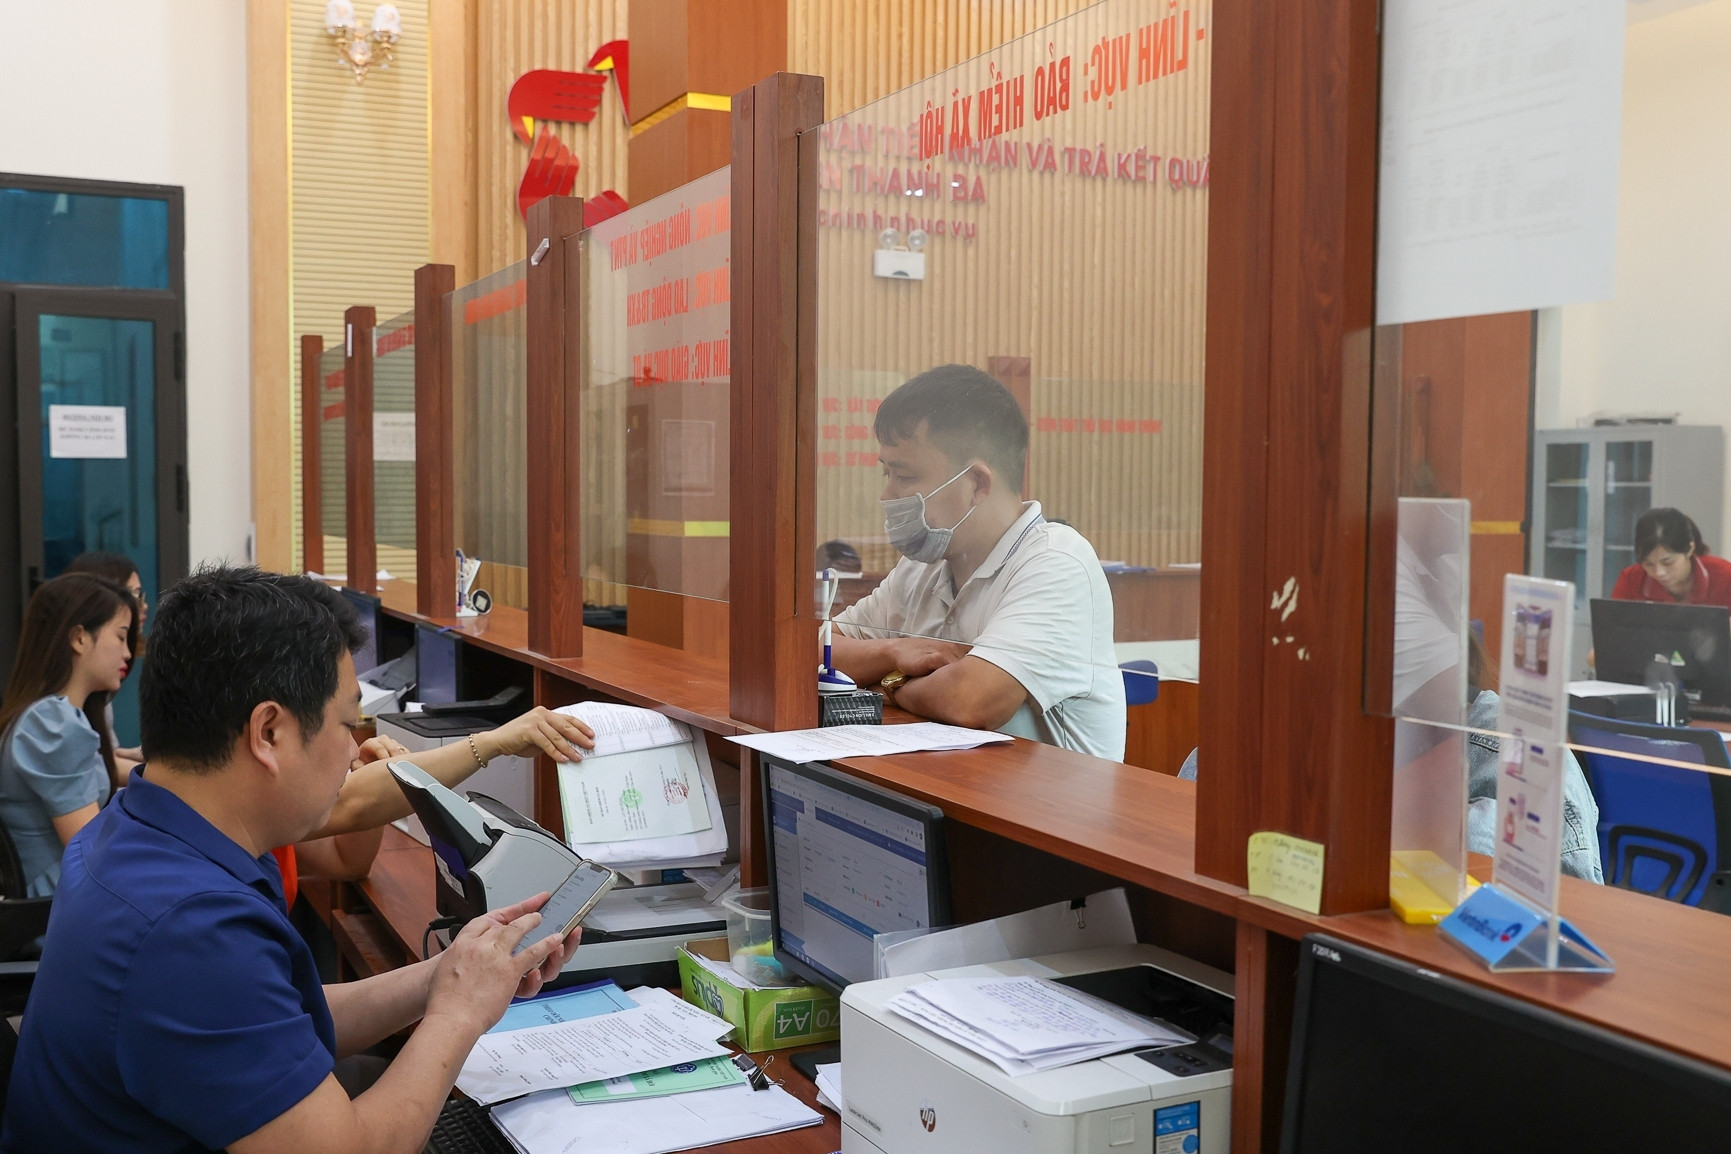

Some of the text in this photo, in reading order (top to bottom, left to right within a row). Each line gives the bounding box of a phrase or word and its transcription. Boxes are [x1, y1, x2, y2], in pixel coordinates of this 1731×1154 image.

[1025, 138, 1058, 172] VÀ
[1064, 144, 1109, 179] TRẢ
[1114, 145, 1161, 183] KẾT
[850, 164, 941, 199] THANH
[950, 173, 987, 203] BA
[777, 1011, 811, 1034] A4
